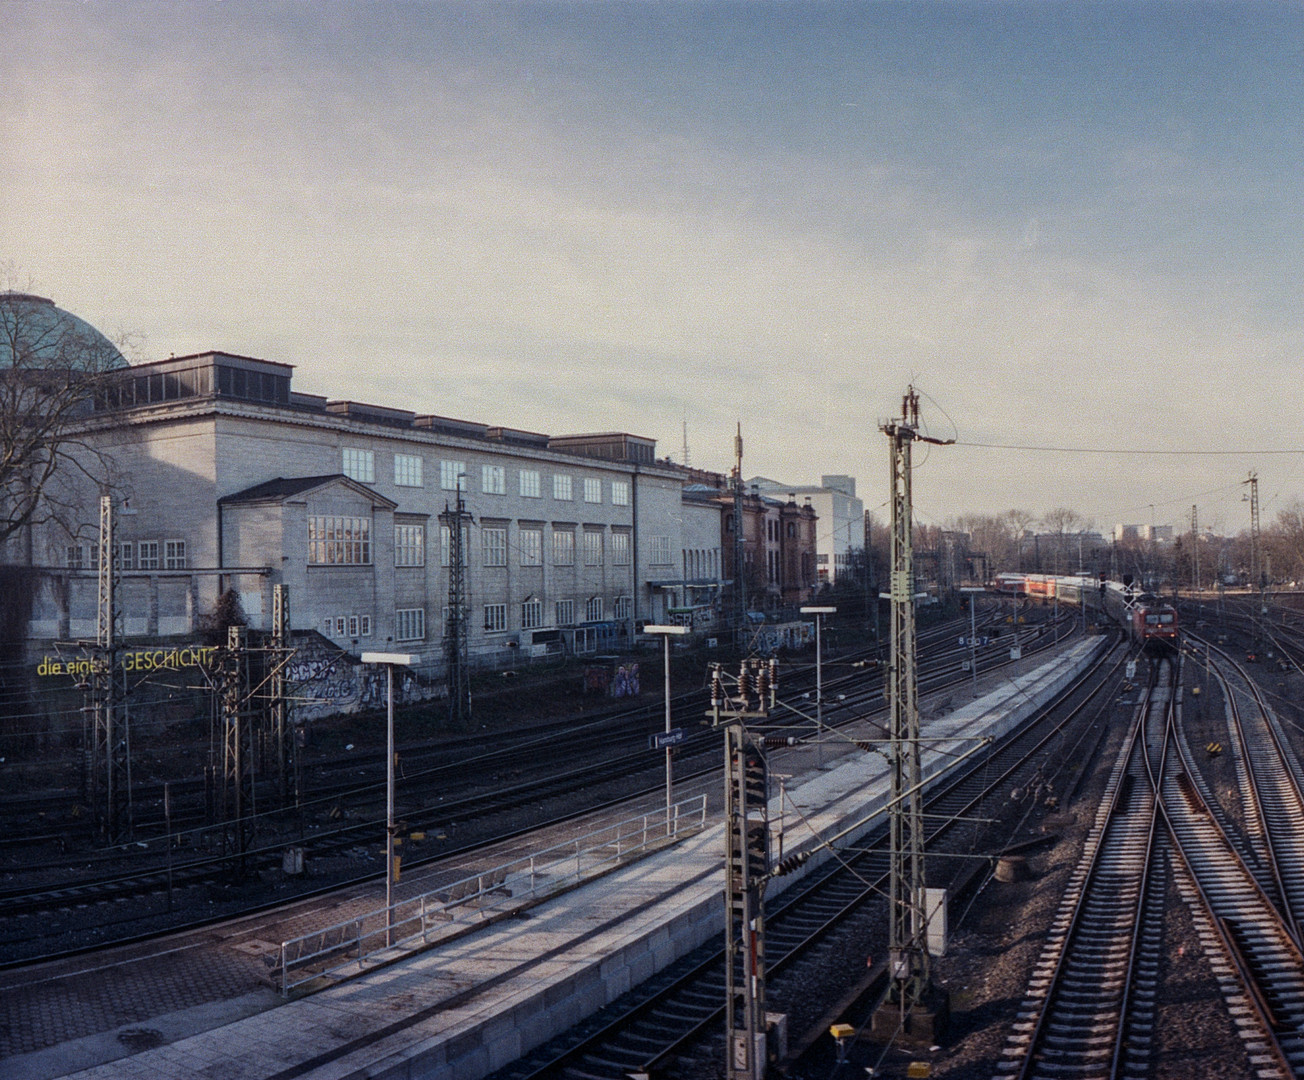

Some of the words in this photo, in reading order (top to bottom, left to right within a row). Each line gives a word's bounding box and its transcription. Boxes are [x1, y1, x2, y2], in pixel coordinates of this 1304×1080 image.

[958, 636, 965, 645] 8
[982, 636, 988, 645] 7
[37, 655, 61, 676] die
